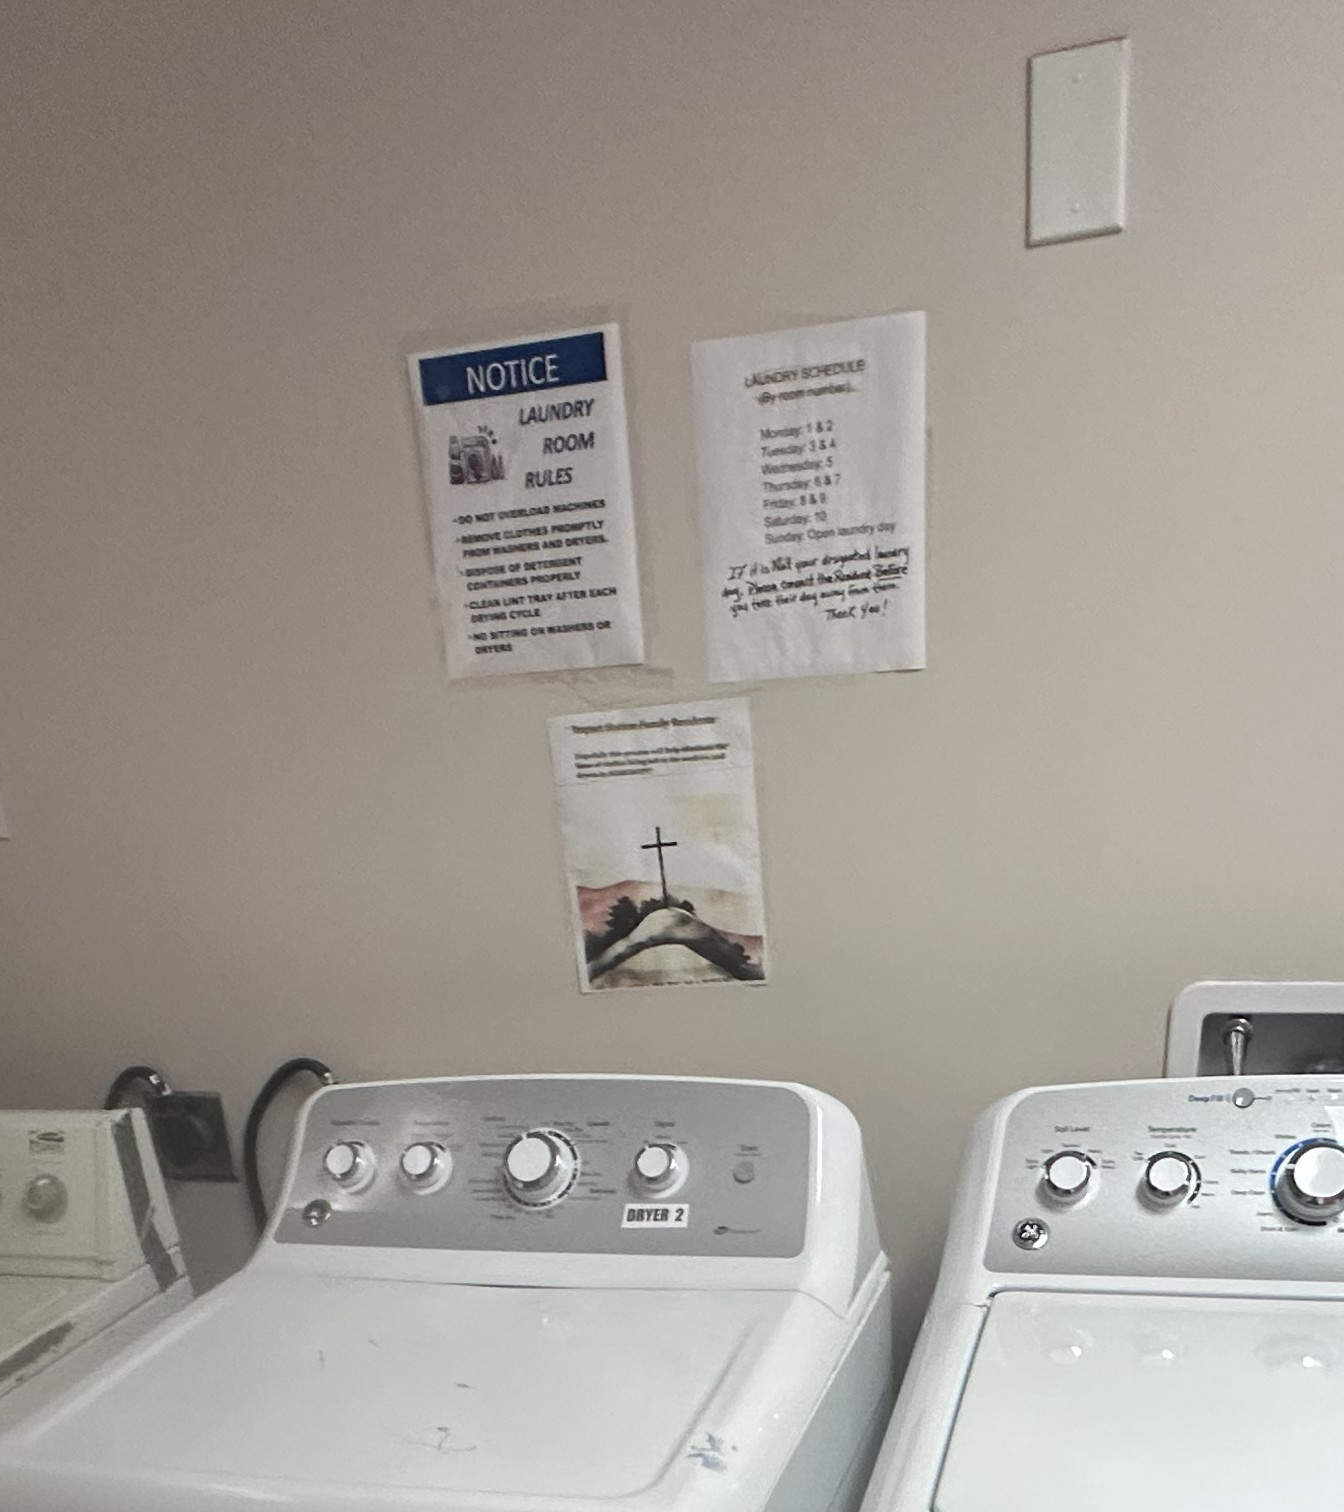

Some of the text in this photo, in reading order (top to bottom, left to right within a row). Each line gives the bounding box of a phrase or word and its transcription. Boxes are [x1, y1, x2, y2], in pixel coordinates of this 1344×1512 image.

[466, 354, 559, 394] NOTICE
[745, 359, 865, 388] LAUNDRY SCHEDULE
[519, 398, 595, 425] LAUNDRY
[826, 420, 833, 432] 2
[543, 432, 594, 455] ROOM
[809, 440, 816, 451] 3
[829, 438, 837, 448] 4
[826, 456, 833, 468] 5
[525, 467, 572, 489] RULES
[476, 512, 495, 522] NOT
[498, 506, 550, 520] OVERLOAD
[553, 499, 605, 513] MACHINES
[461, 520, 604, 544] REMOVE CLOTHES PROMPTLY
[807, 528, 836, 540] Open
[877, 522, 896, 534] day
[463, 548, 490, 558] FROM
[493, 541, 540, 554] WASHERS
[543, 539, 563, 550] AND
[465, 565, 505, 576] DISPOSE
[508, 563, 521, 572] OF
[467, 571, 581, 591] CONTAINERS PROPERLY
[469, 600, 500, 609] CLEAN
[503, 597, 524, 607] LINT
[556, 591, 587, 601] AFTER
[589, 587, 617, 598] EACH
[509, 608, 540, 619] CYCLE
[729, 602, 748, 618] you
[490, 629, 528, 640] SITTING
[547, 623, 594, 634] WASHERS
[597, 621, 611, 629] OR
[627, 1208, 684, 1222] DRYER 2
